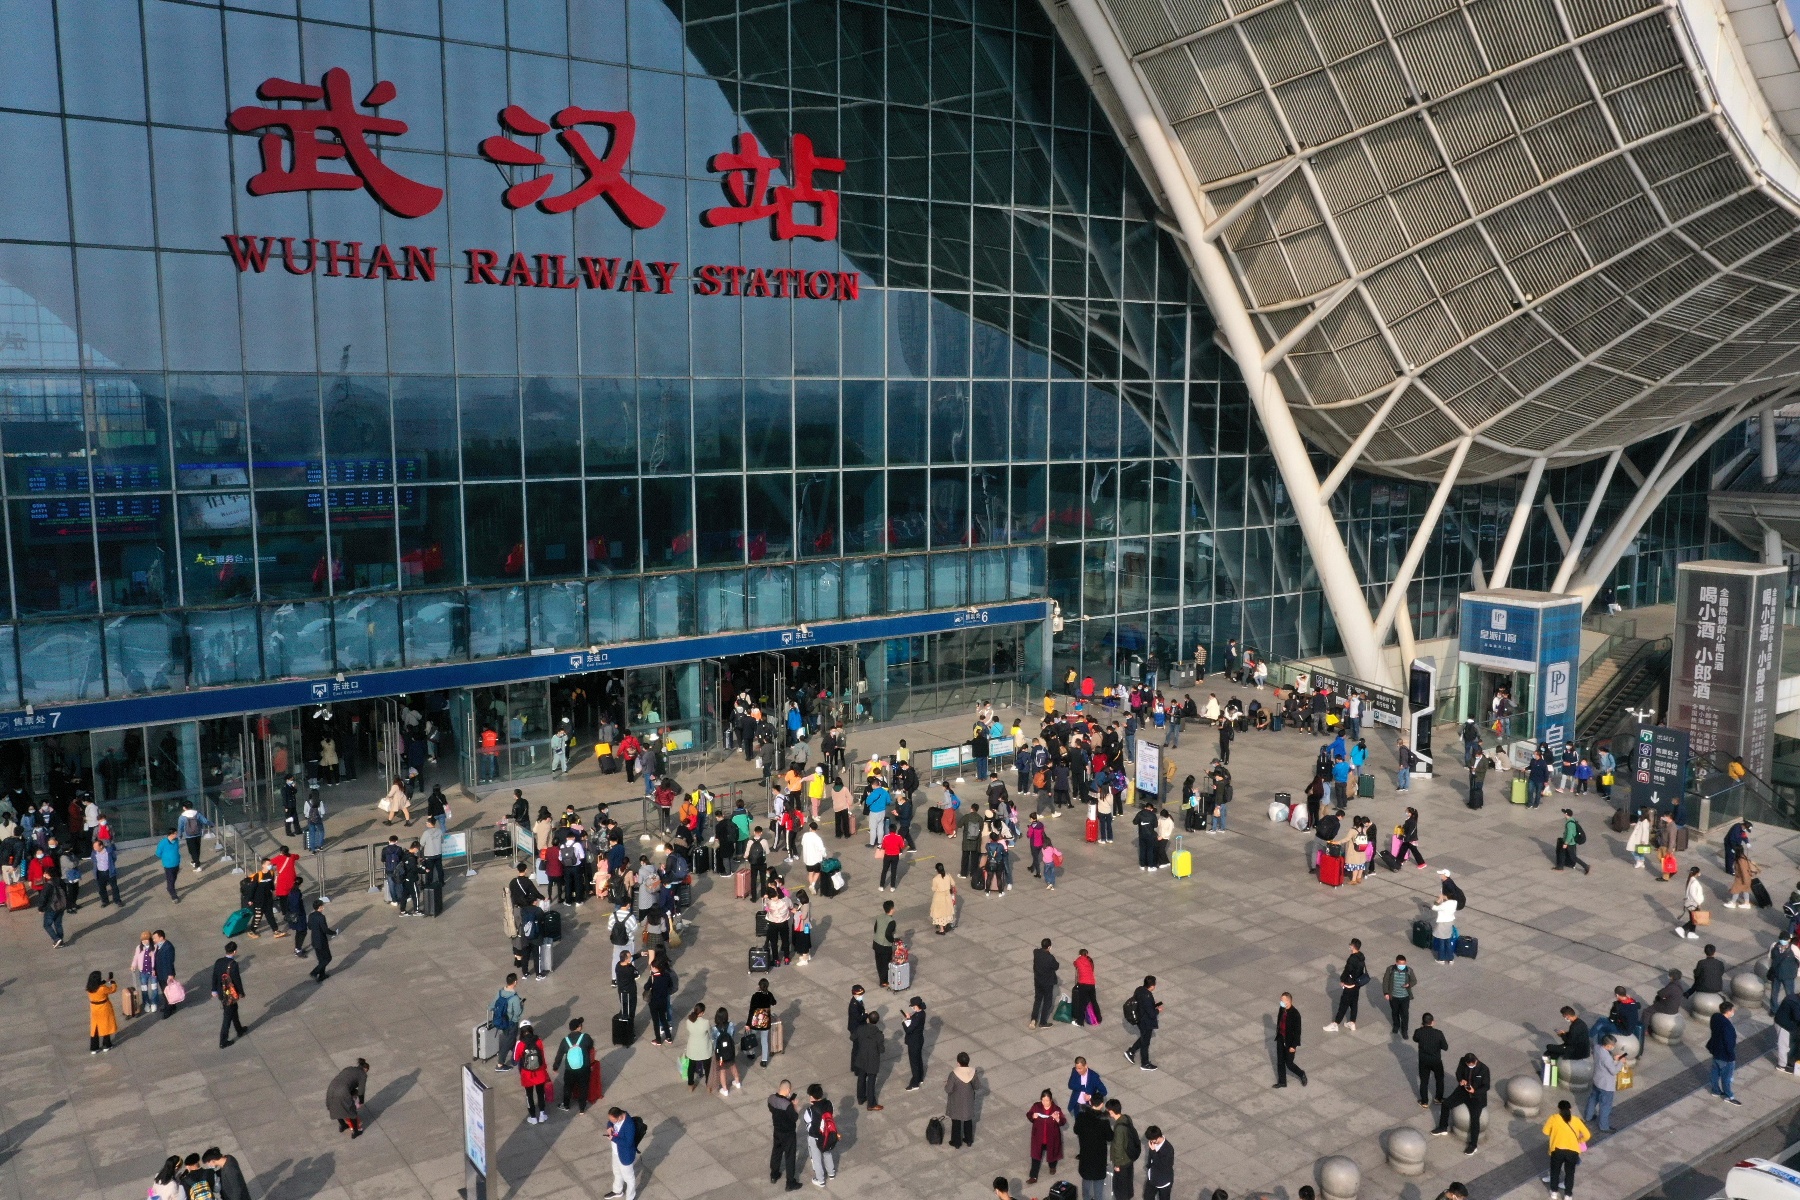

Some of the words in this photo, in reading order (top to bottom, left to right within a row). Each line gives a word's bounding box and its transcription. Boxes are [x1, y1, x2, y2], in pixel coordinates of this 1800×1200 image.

[228, 67, 846, 241] 武汉站
[223, 235, 437, 282] WUHAN
[465, 248, 680, 295] RAILWAY
[695, 265, 860, 301] STATION
[981, 611, 988, 623] 6
[1697, 586, 1717, 639] 喝小酒
[586, 653, 608, 663] 东进口
[1693, 646, 1713, 700] 小郎酒
[332, 681, 359, 691] 东进口
[13, 714, 46, 727] 售票处
[49, 711, 61, 729] 7
